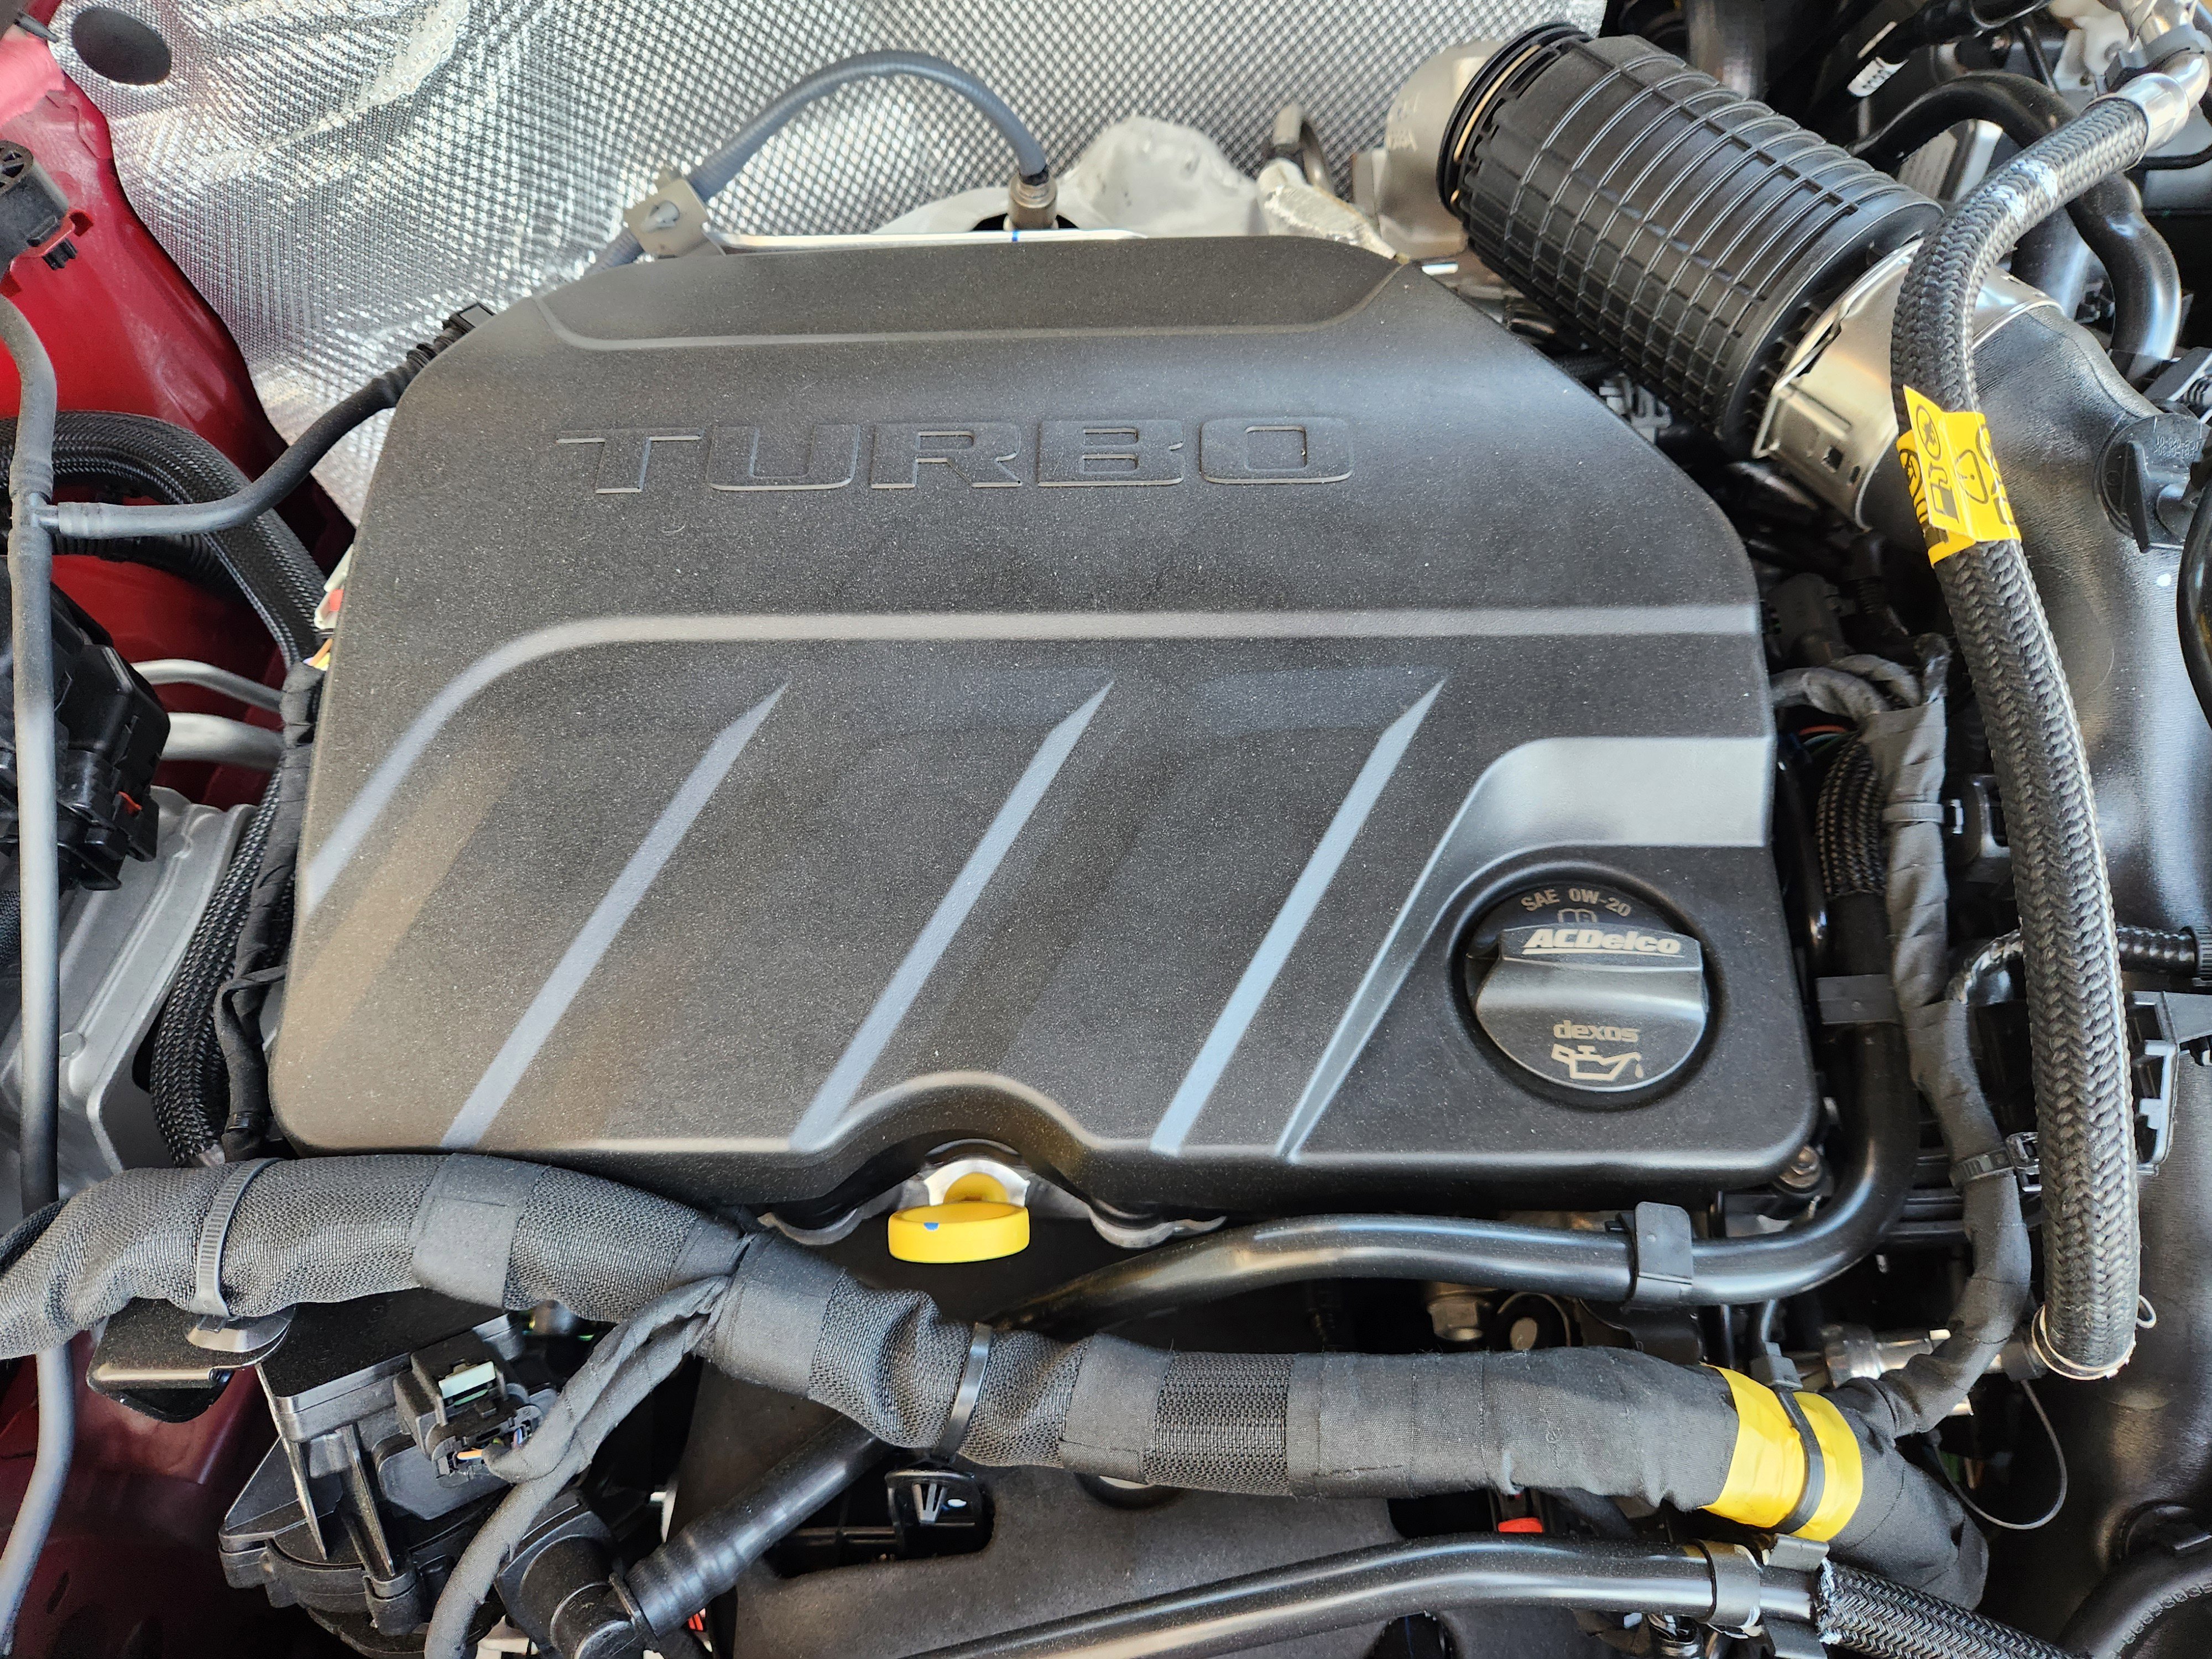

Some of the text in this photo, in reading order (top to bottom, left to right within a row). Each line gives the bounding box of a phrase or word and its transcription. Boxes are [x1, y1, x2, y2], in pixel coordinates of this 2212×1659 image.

[555, 416, 1354, 494] TURBO
[1521, 888, 1631, 917] SAE 0W-20
[1523, 928, 1681, 954] ACDelco
[1553, 1020, 1641, 1042] dexos
